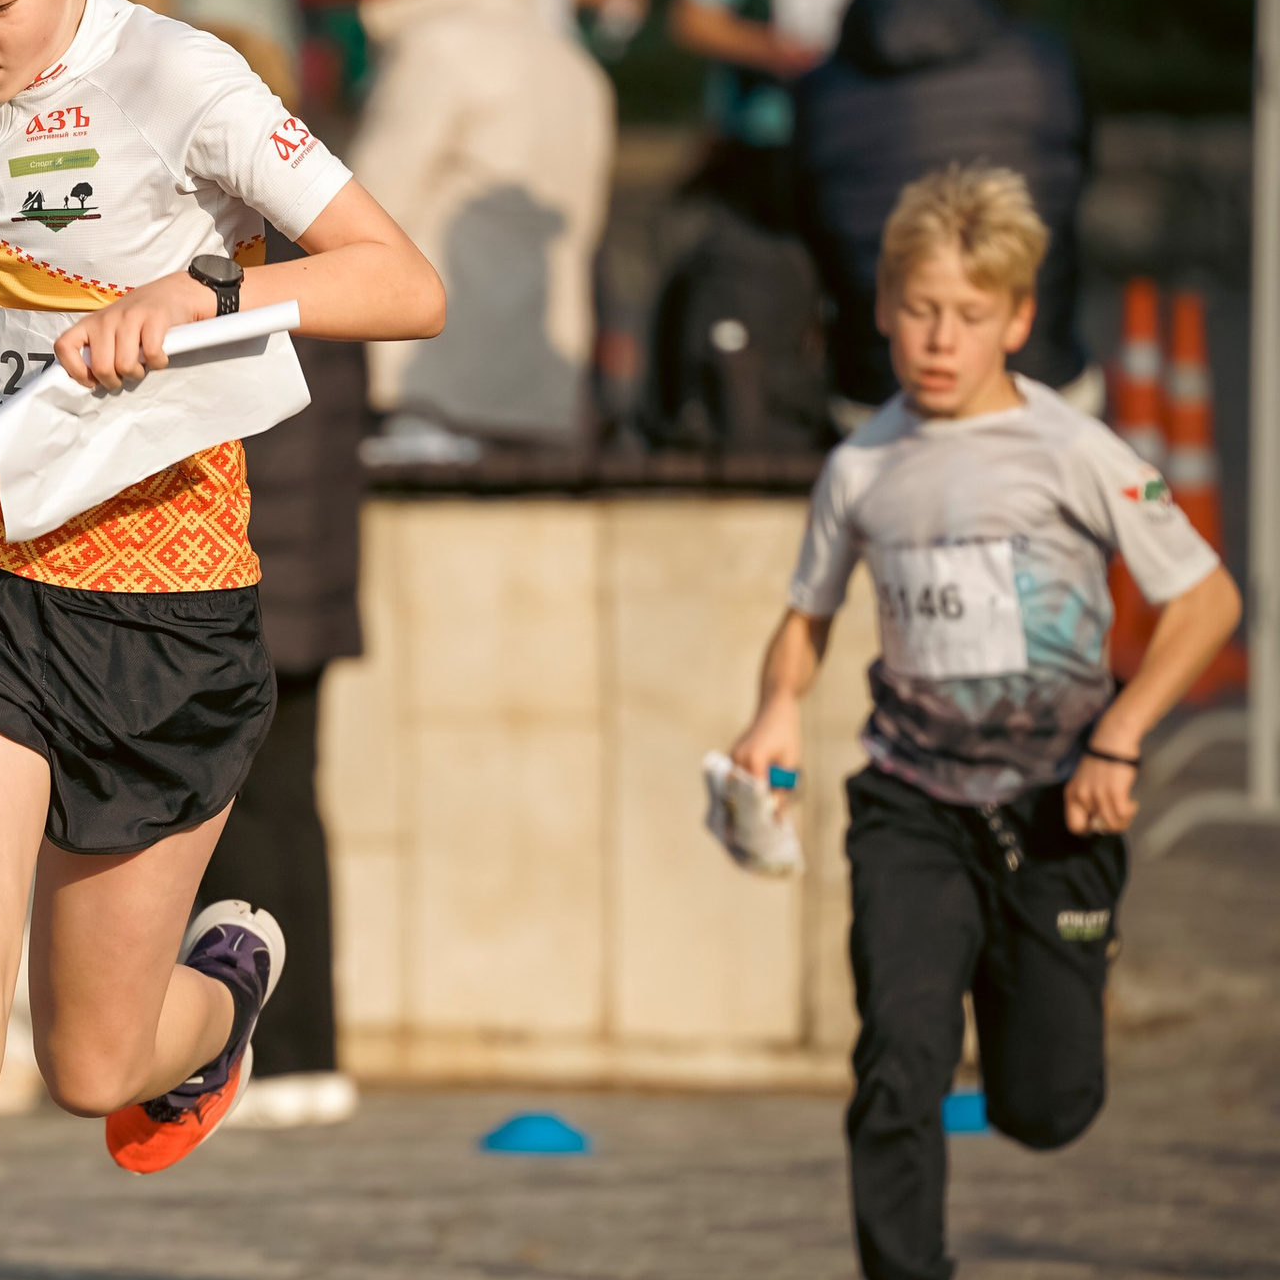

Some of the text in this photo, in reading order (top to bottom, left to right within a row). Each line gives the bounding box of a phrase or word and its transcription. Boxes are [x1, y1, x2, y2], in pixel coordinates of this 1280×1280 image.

[26, 106, 90, 135] АЗЪ
[26, 132, 69, 142] СПОРТИВНЫЙ
[269, 117, 310, 161] АЗ
[29, 159, 53, 169] Спорт
